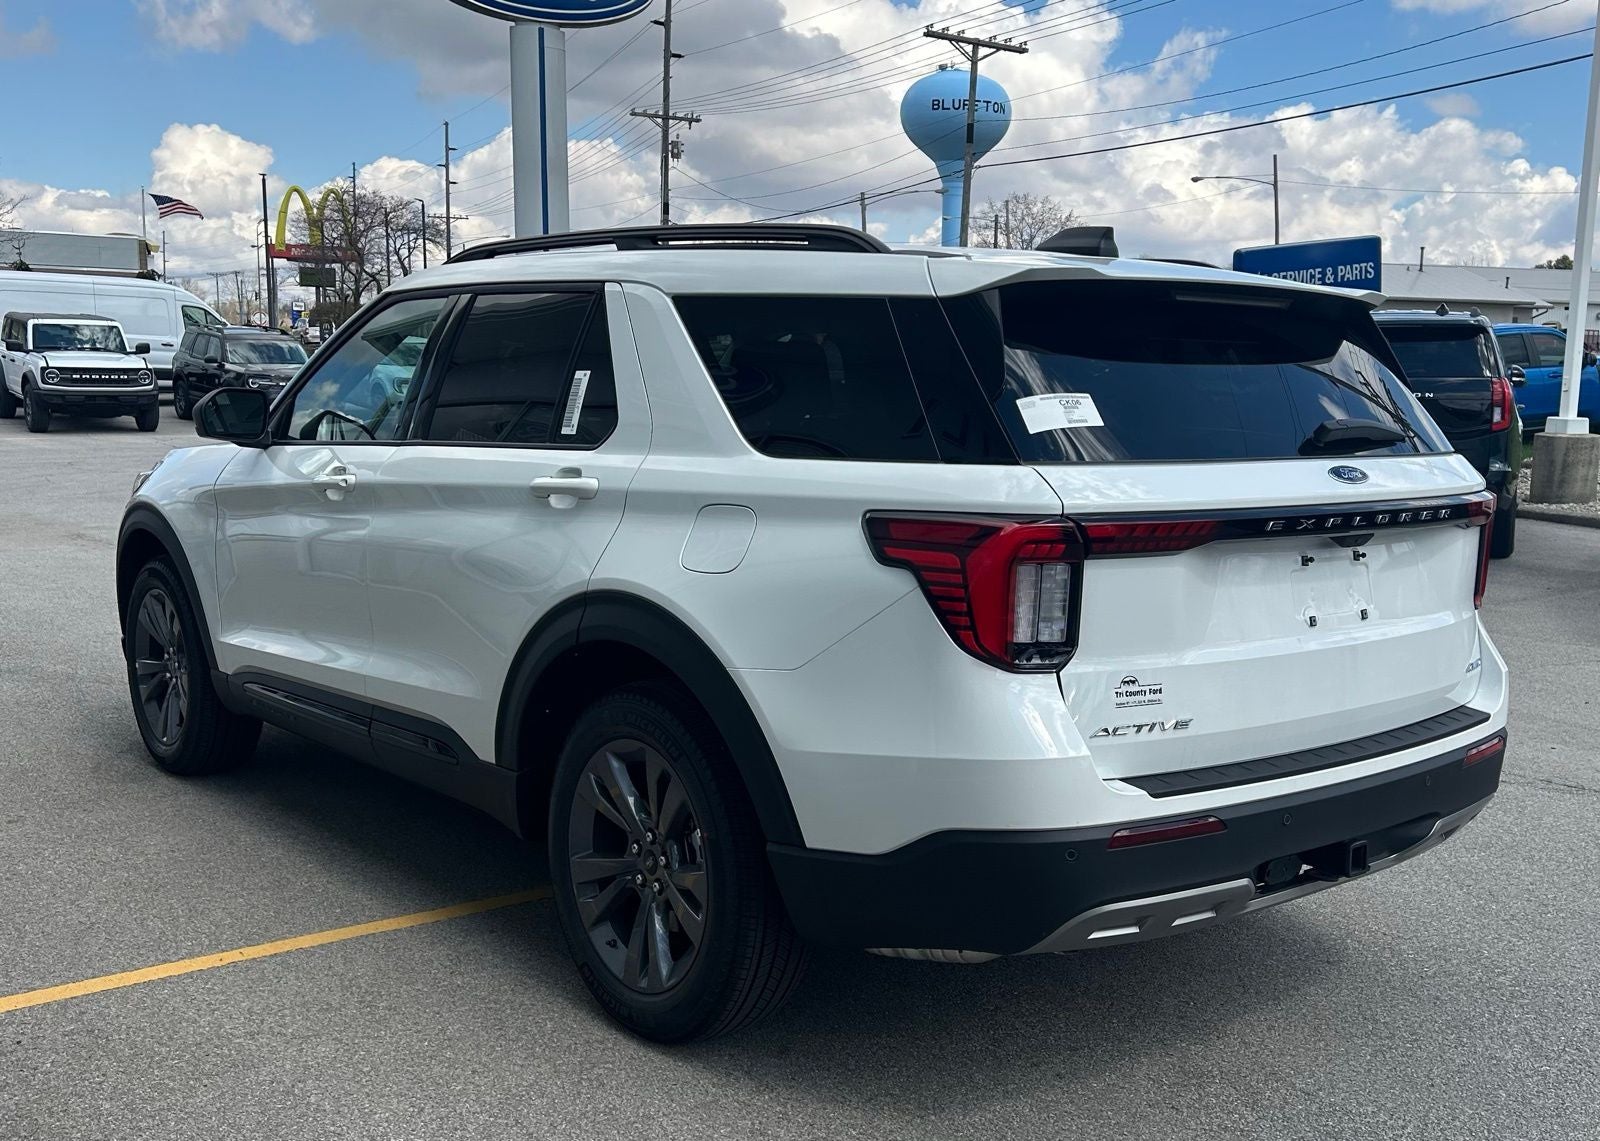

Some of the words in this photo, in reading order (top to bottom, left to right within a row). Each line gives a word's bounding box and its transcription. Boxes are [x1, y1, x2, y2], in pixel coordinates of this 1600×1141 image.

[931, 98, 1006, 114] BLUFFTON
[1325, 266, 1335, 284] &
[1337, 261, 1375, 282] PARTS
[1265, 508, 1451, 532] EXPLORER
[1114, 691, 1124, 699] Tri
[1125, 688, 1147, 698] County
[1148, 687, 1162, 696] Ford
[1089, 719, 1194, 739] ACTIVE
